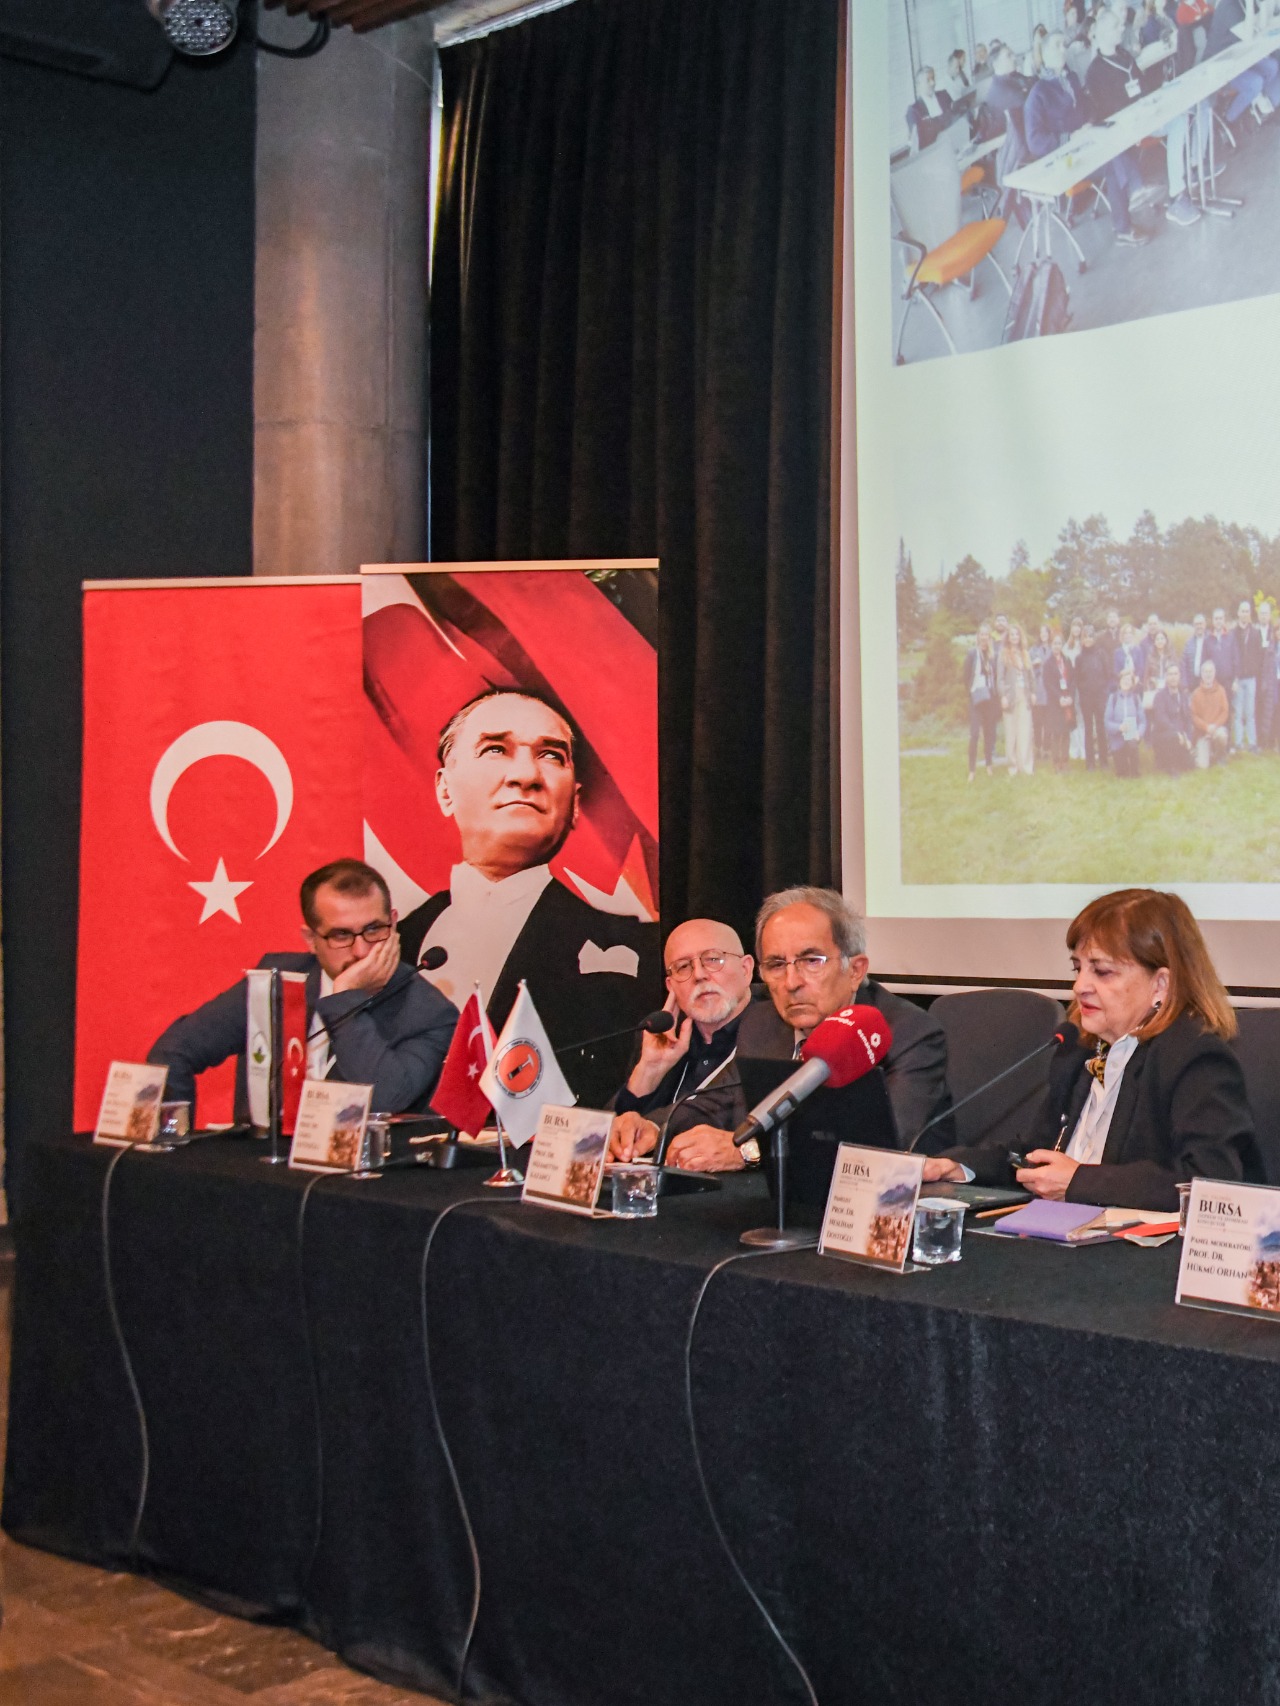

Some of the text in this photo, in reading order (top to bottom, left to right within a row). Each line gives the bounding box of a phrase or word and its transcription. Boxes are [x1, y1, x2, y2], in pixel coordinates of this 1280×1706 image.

[544, 1114, 569, 1127] BURSA
[842, 1163, 870, 1177] BURSA
[1199, 1199, 1242, 1217] BURSA
[1216, 1267, 1248, 1279] ORHAN
